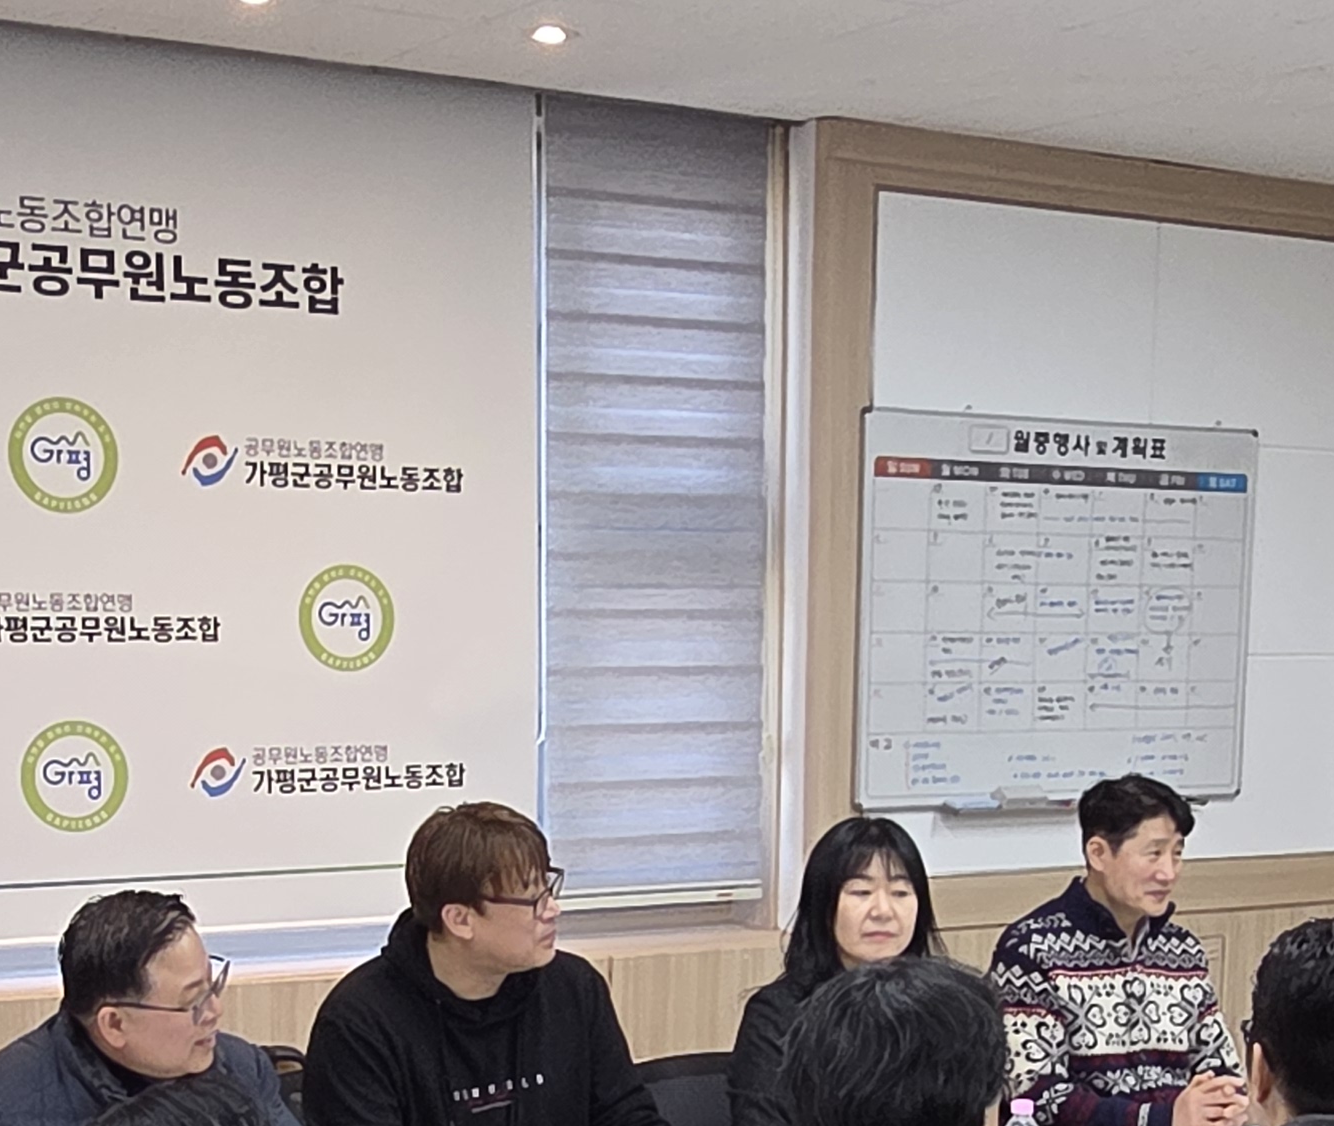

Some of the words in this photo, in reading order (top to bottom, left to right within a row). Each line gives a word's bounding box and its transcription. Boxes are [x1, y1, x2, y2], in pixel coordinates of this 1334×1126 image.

[244, 437, 384, 462] 공무원노동조합연맹
[1013, 430, 1090, 457] 월중행사
[1112, 435, 1166, 460] 계획표
[244, 460, 464, 494] 가평군공무원노동조합
[252, 744, 388, 767] 공무원노동조합연맹
[252, 762, 466, 794] 가평군공무원노동조합
